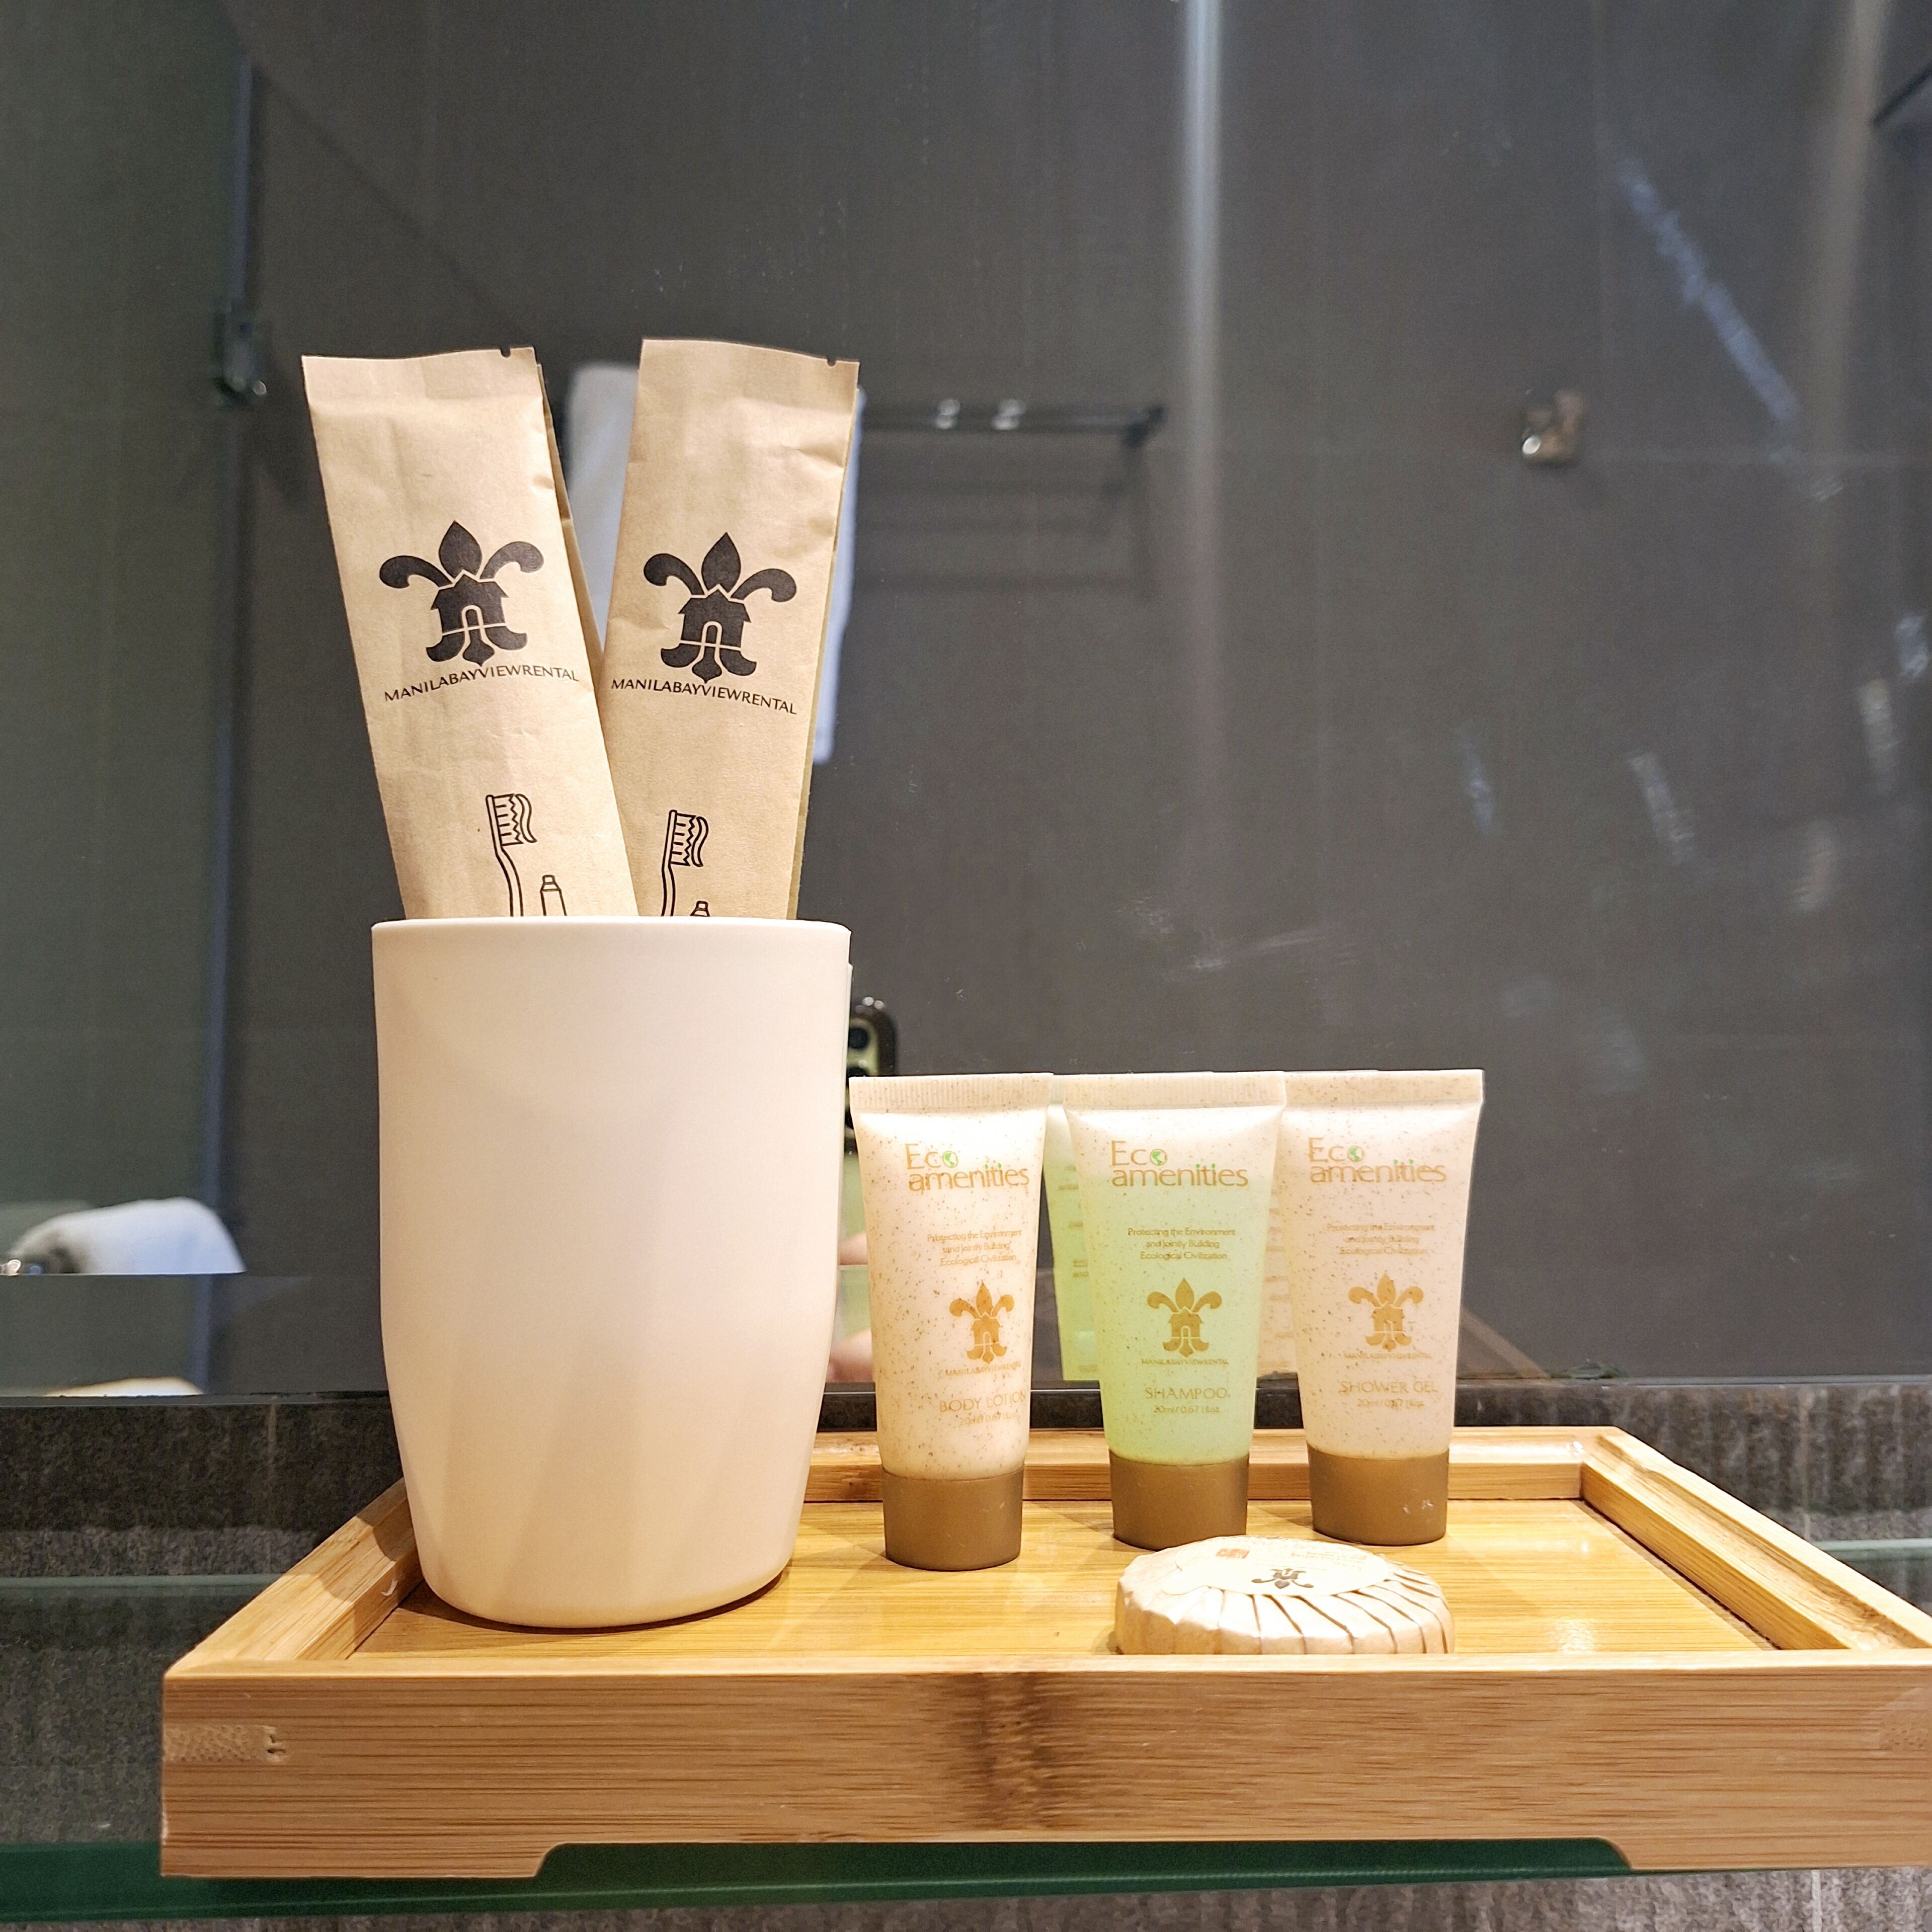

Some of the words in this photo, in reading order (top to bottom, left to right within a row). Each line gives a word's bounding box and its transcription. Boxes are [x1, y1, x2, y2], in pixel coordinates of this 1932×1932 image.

[384, 665, 580, 702] MANILABAYVIEWRENTAL
[611, 679, 797, 715] MANILABAYVIEWRENTAL
[905, 1143, 958, 1169] Eco
[1111, 1141, 1168, 1166] Eco
[1309, 1137, 1365, 1162] Eco
[908, 1163, 1030, 1191] amenities
[1111, 1163, 1248, 1187] amenities
[1310, 1159, 1447, 1183] amenities
[968, 1231, 979, 1239] the
[1128, 1227, 1169, 1237] Protecting
[1170, 1228, 1182, 1237] the
[1185, 1227, 1236, 1236] Environment
[984, 1242, 1010, 1251] Building
[1146, 1239, 1161, 1248] and
[1188, 1239, 1220, 1248] Building
[940, 1255, 979, 1266] Ecological
[981, 1254, 1016, 1263] Civilization
[1140, 1251, 1181, 1260] Ecological
[1183, 1251, 1227, 1259] Civilization
[1145, 1387, 1227, 1399] SHAMPOO
[1339, 1381, 1409, 1394] SHOWER
[1413, 1381, 1438, 1393] GEL
[939, 1397, 981, 1412] BODY
[987, 1390, 1026, 1408] LOTION
